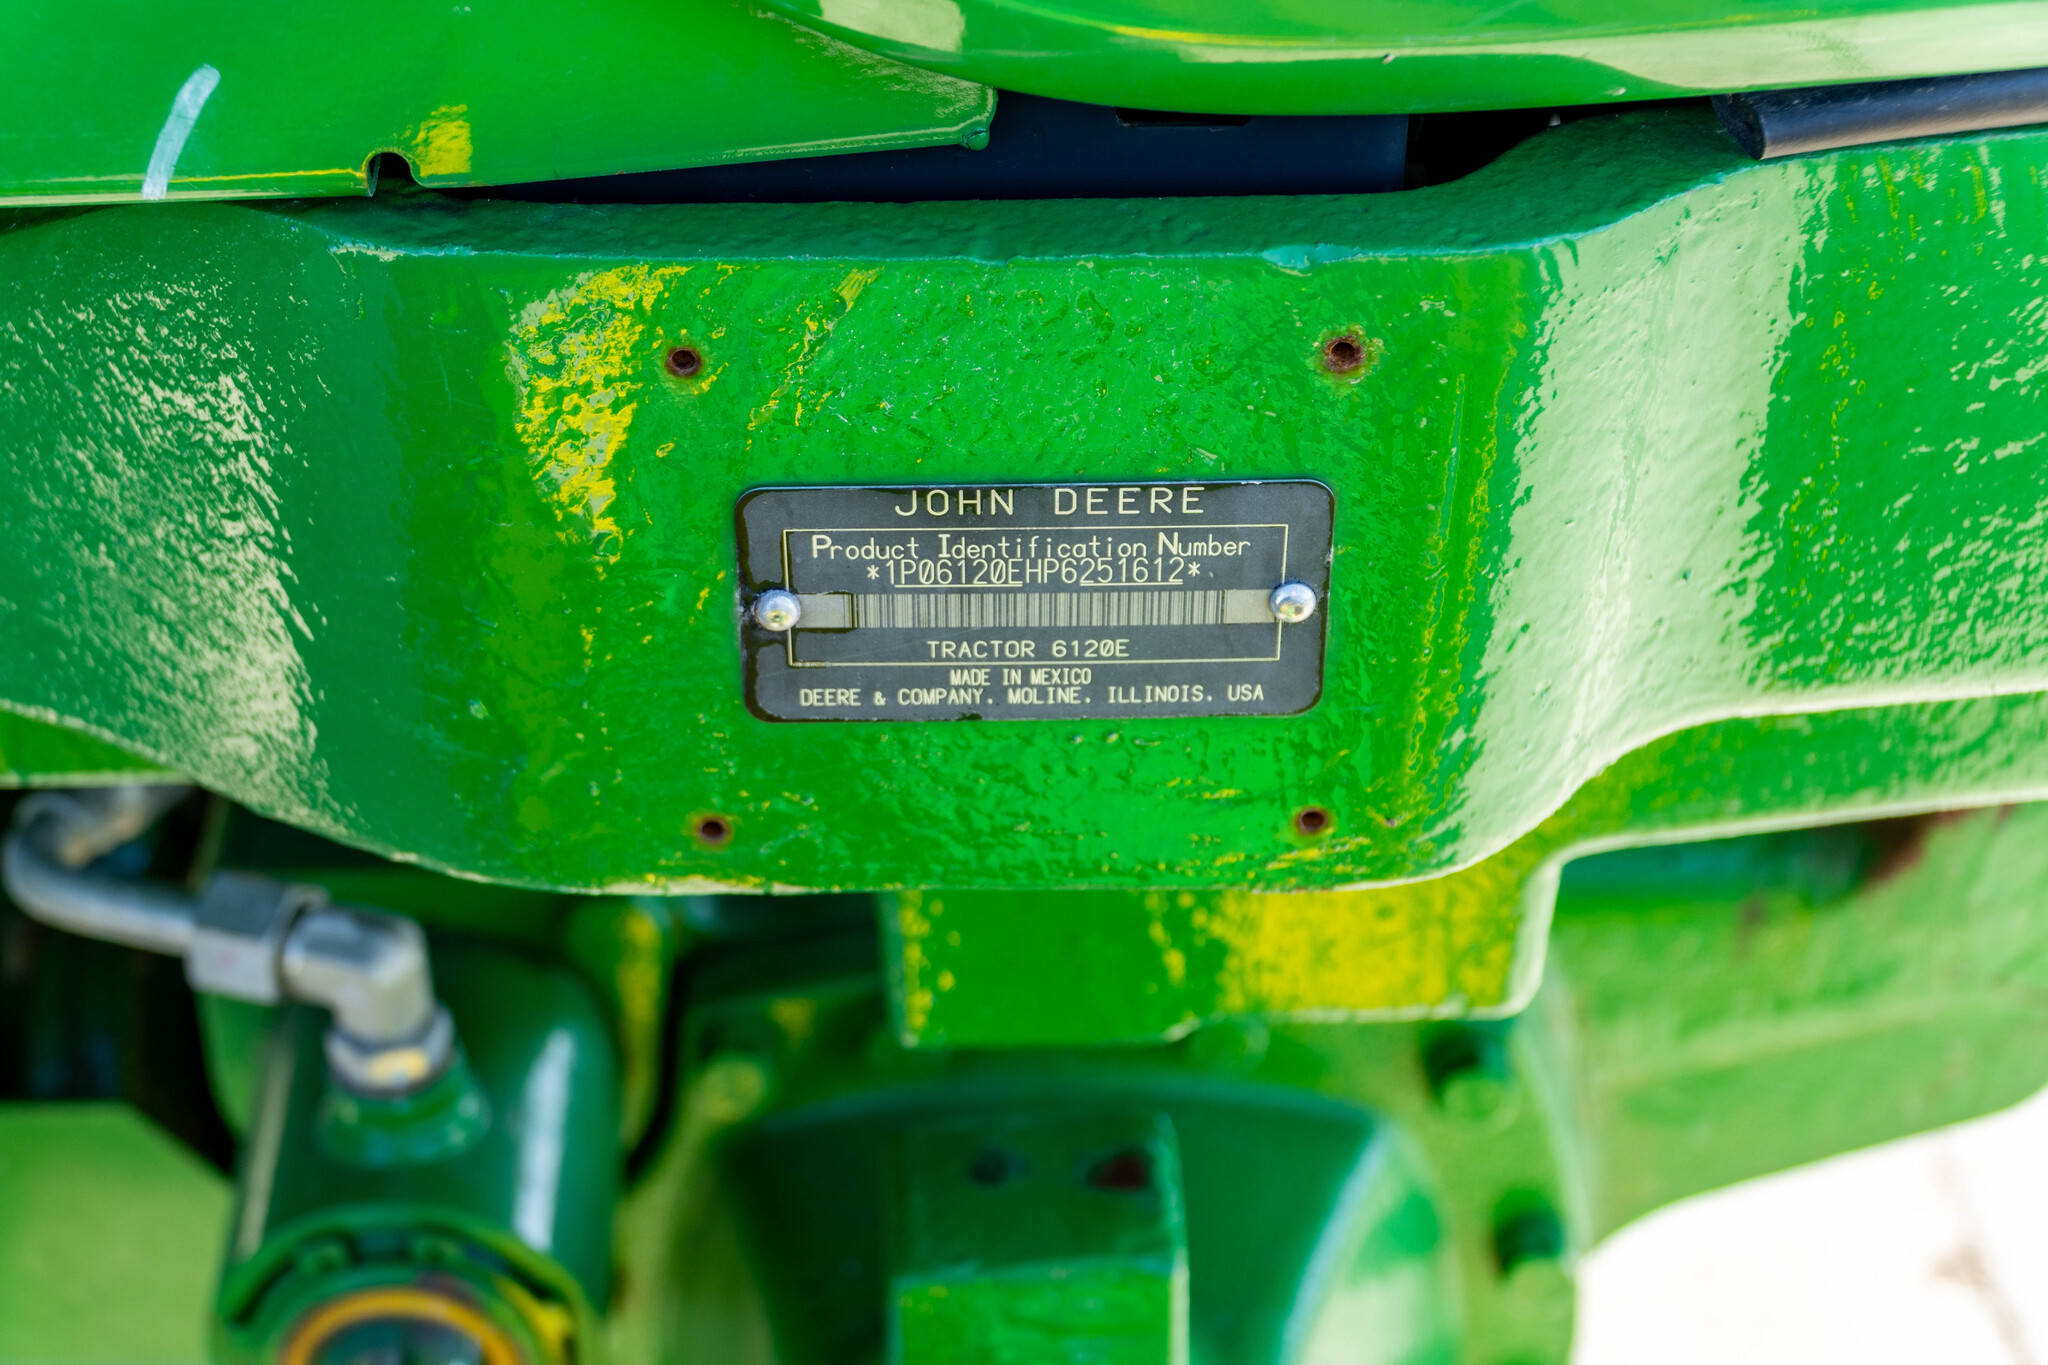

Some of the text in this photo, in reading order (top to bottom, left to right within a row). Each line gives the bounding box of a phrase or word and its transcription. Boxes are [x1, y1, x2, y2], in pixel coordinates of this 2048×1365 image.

[894, 487, 1205, 516] JOHN DEERE
[811, 531, 1251, 560] Product Identification Number
[926, 639, 1130, 659] TRACTOR 6120E
[949, 668, 1092, 686] MADE IN MEXICO
[799, 688, 862, 707] DEERE
[873, 690, 886, 706] &
[1226, 683, 1265, 701] USA
